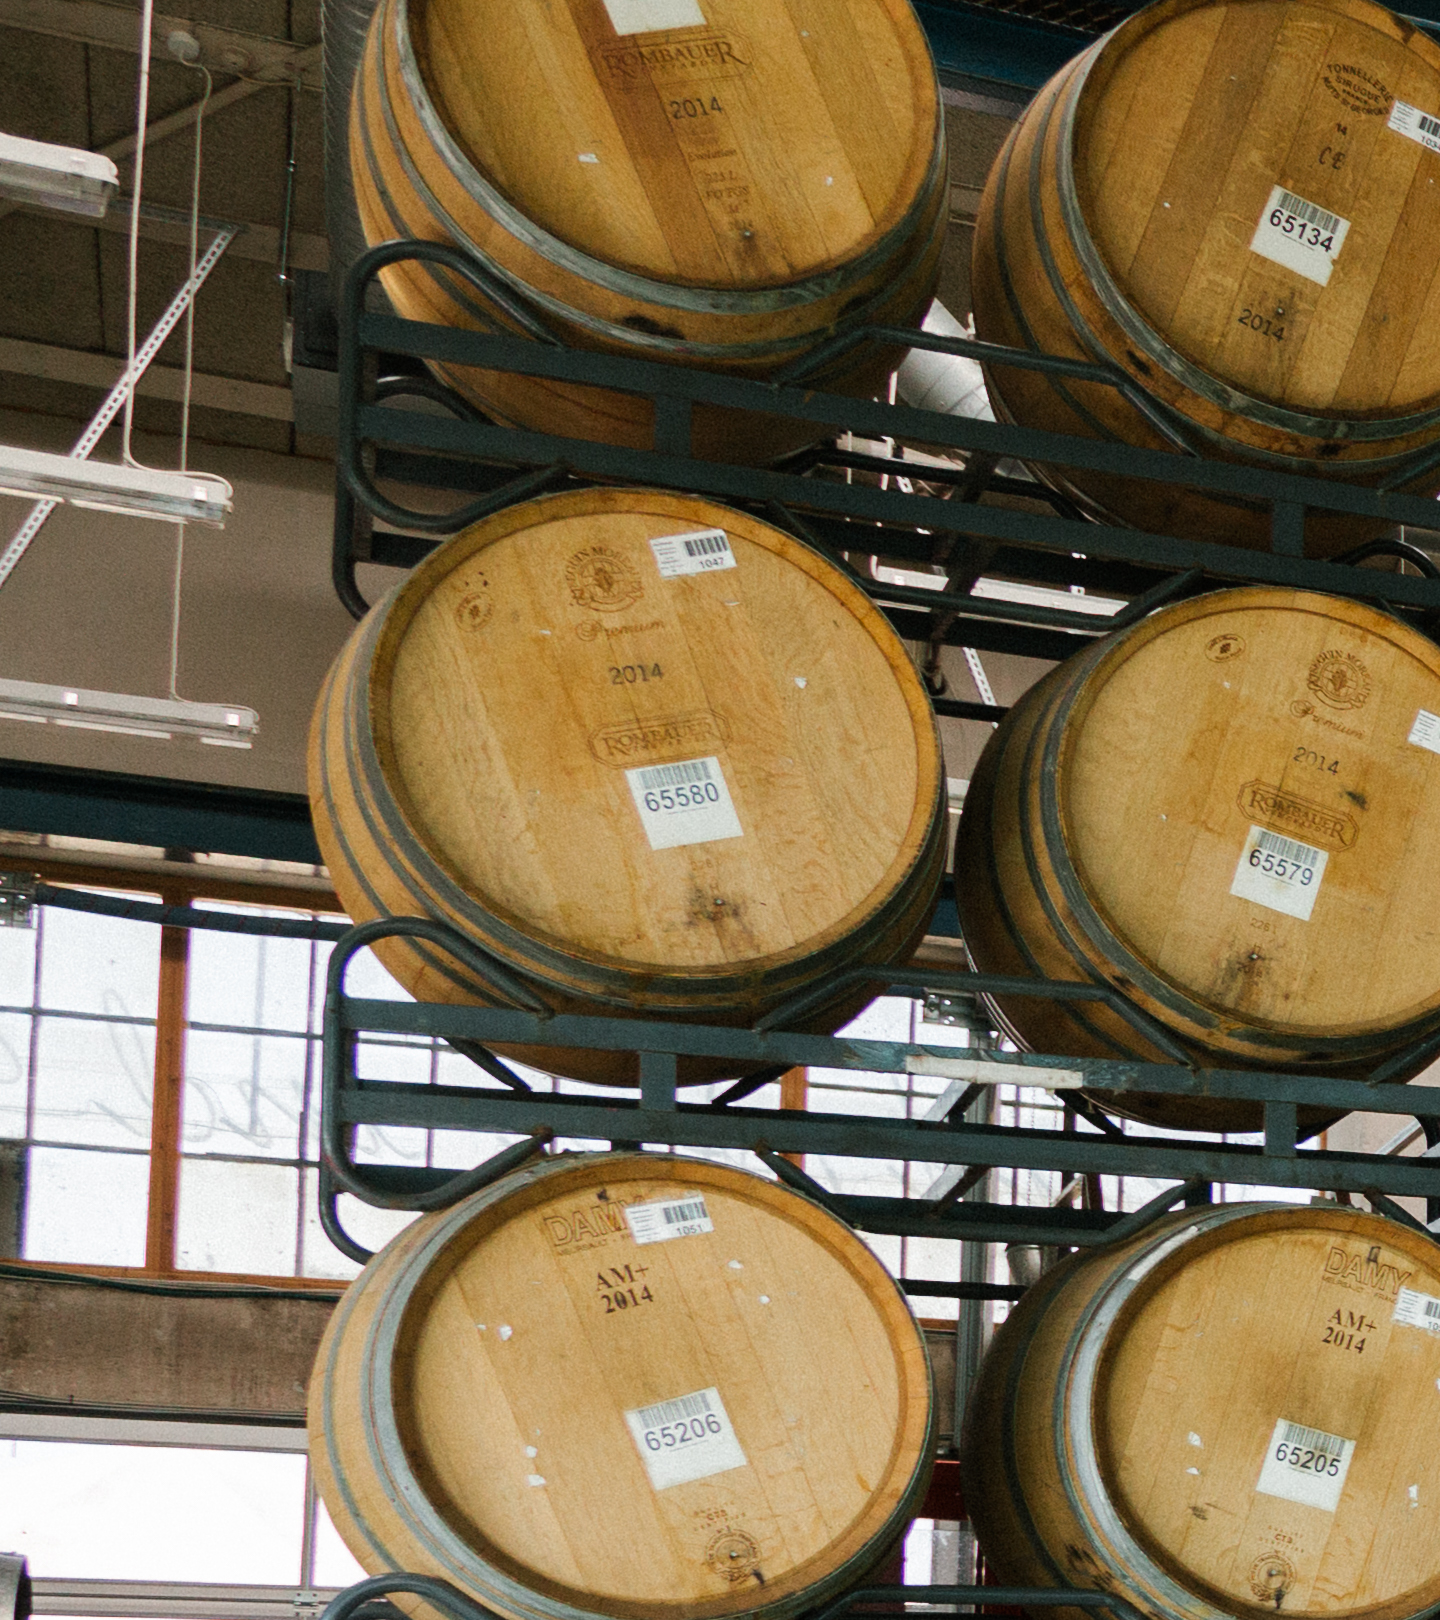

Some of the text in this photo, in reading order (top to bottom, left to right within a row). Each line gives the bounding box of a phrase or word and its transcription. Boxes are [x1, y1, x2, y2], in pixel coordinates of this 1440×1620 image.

[669, 96, 722, 120] 2014
[1269, 208, 1334, 253] 65134
[1238, 308, 1286, 342] 2014
[699, 557, 725, 570] 1047
[608, 662, 663, 686] 2014
[1293, 747, 1340, 776] 2014
[644, 782, 720, 813] 65580
[1249, 848, 1313, 886] 65579
[676, 1223, 704, 1236] 1051
[597, 1264, 648, 1291] AM+
[1324, 1246, 1411, 1295] DAMY
[600, 1285, 653, 1313] 2014
[1327, 1309, 1377, 1333] AM+
[1322, 1327, 1367, 1354] 2014
[644, 1413, 721, 1451] 65206
[1275, 1443, 1341, 1477] 65205
